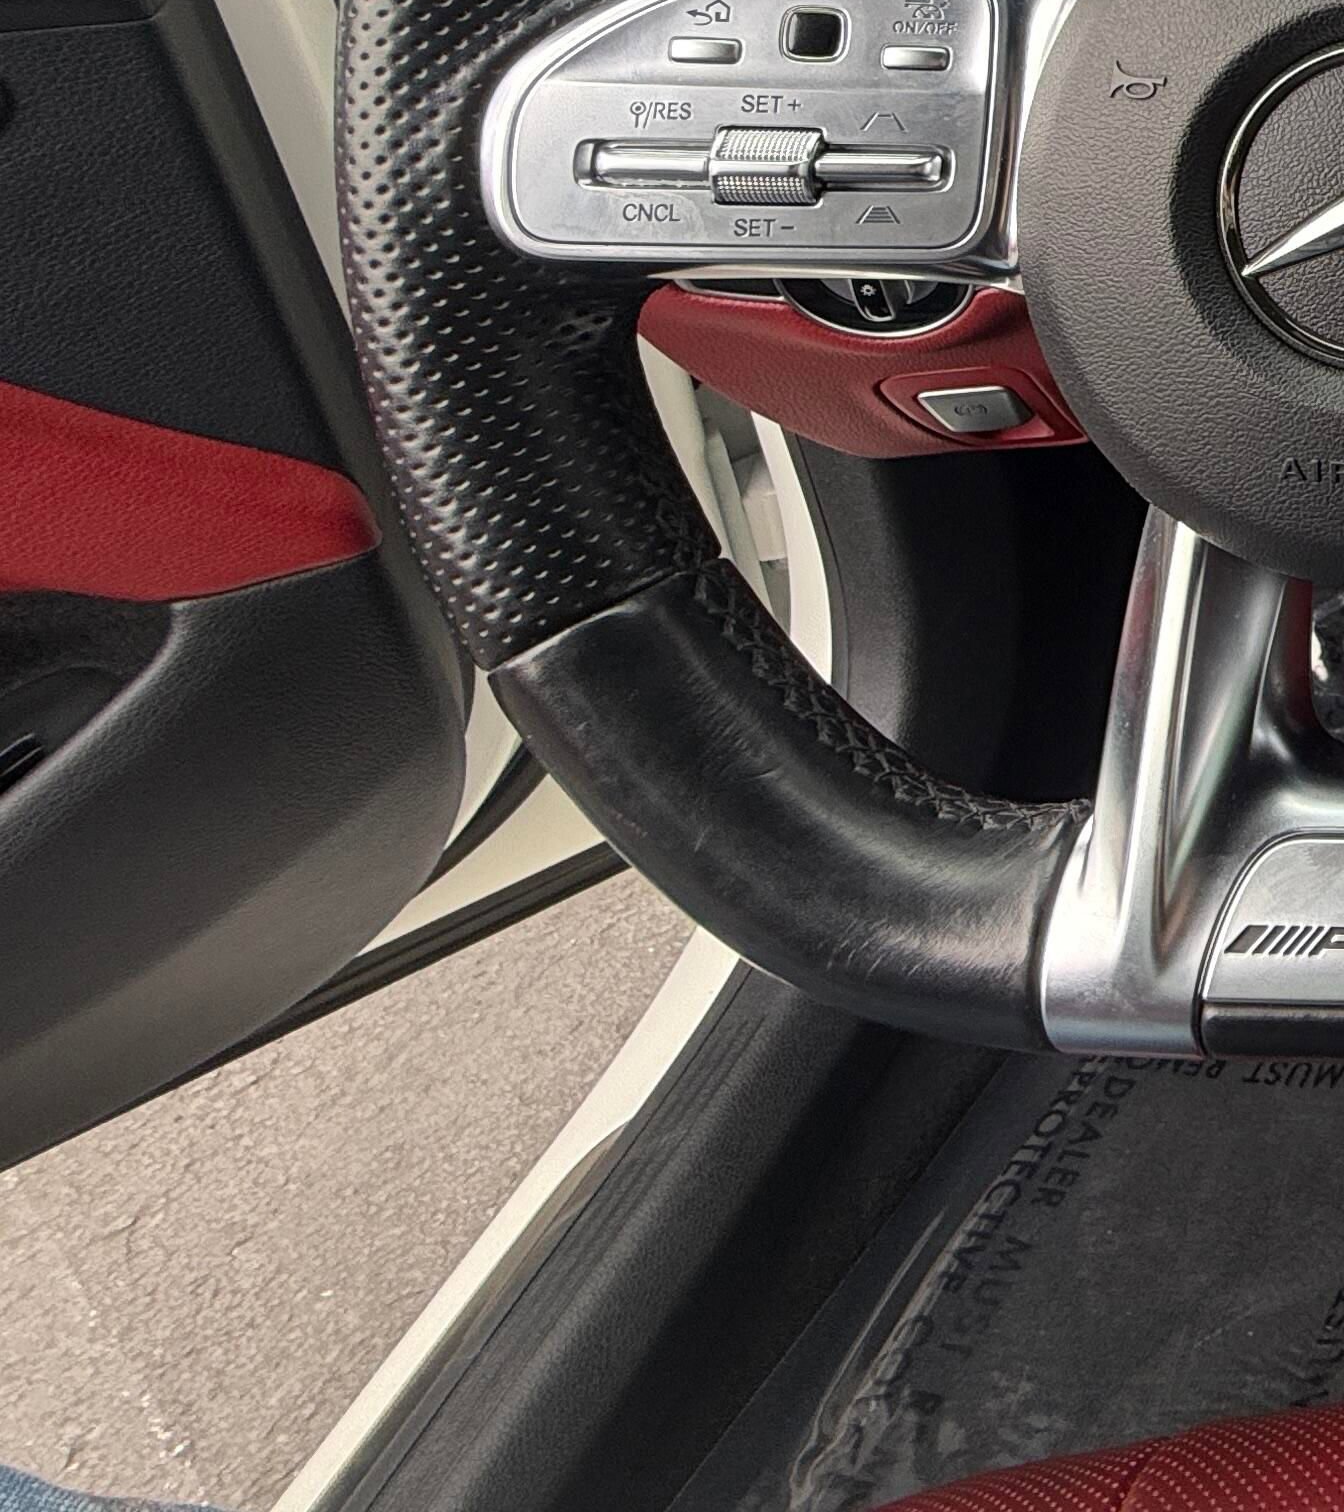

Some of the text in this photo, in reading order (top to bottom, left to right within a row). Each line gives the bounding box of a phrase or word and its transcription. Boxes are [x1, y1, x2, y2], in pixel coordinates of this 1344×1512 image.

[740, 95, 783, 114] SET
[622, 204, 681, 222] CNCL
[733, 218, 776, 237] SET
[1031, 1074, 1137, 1209] DEALER
